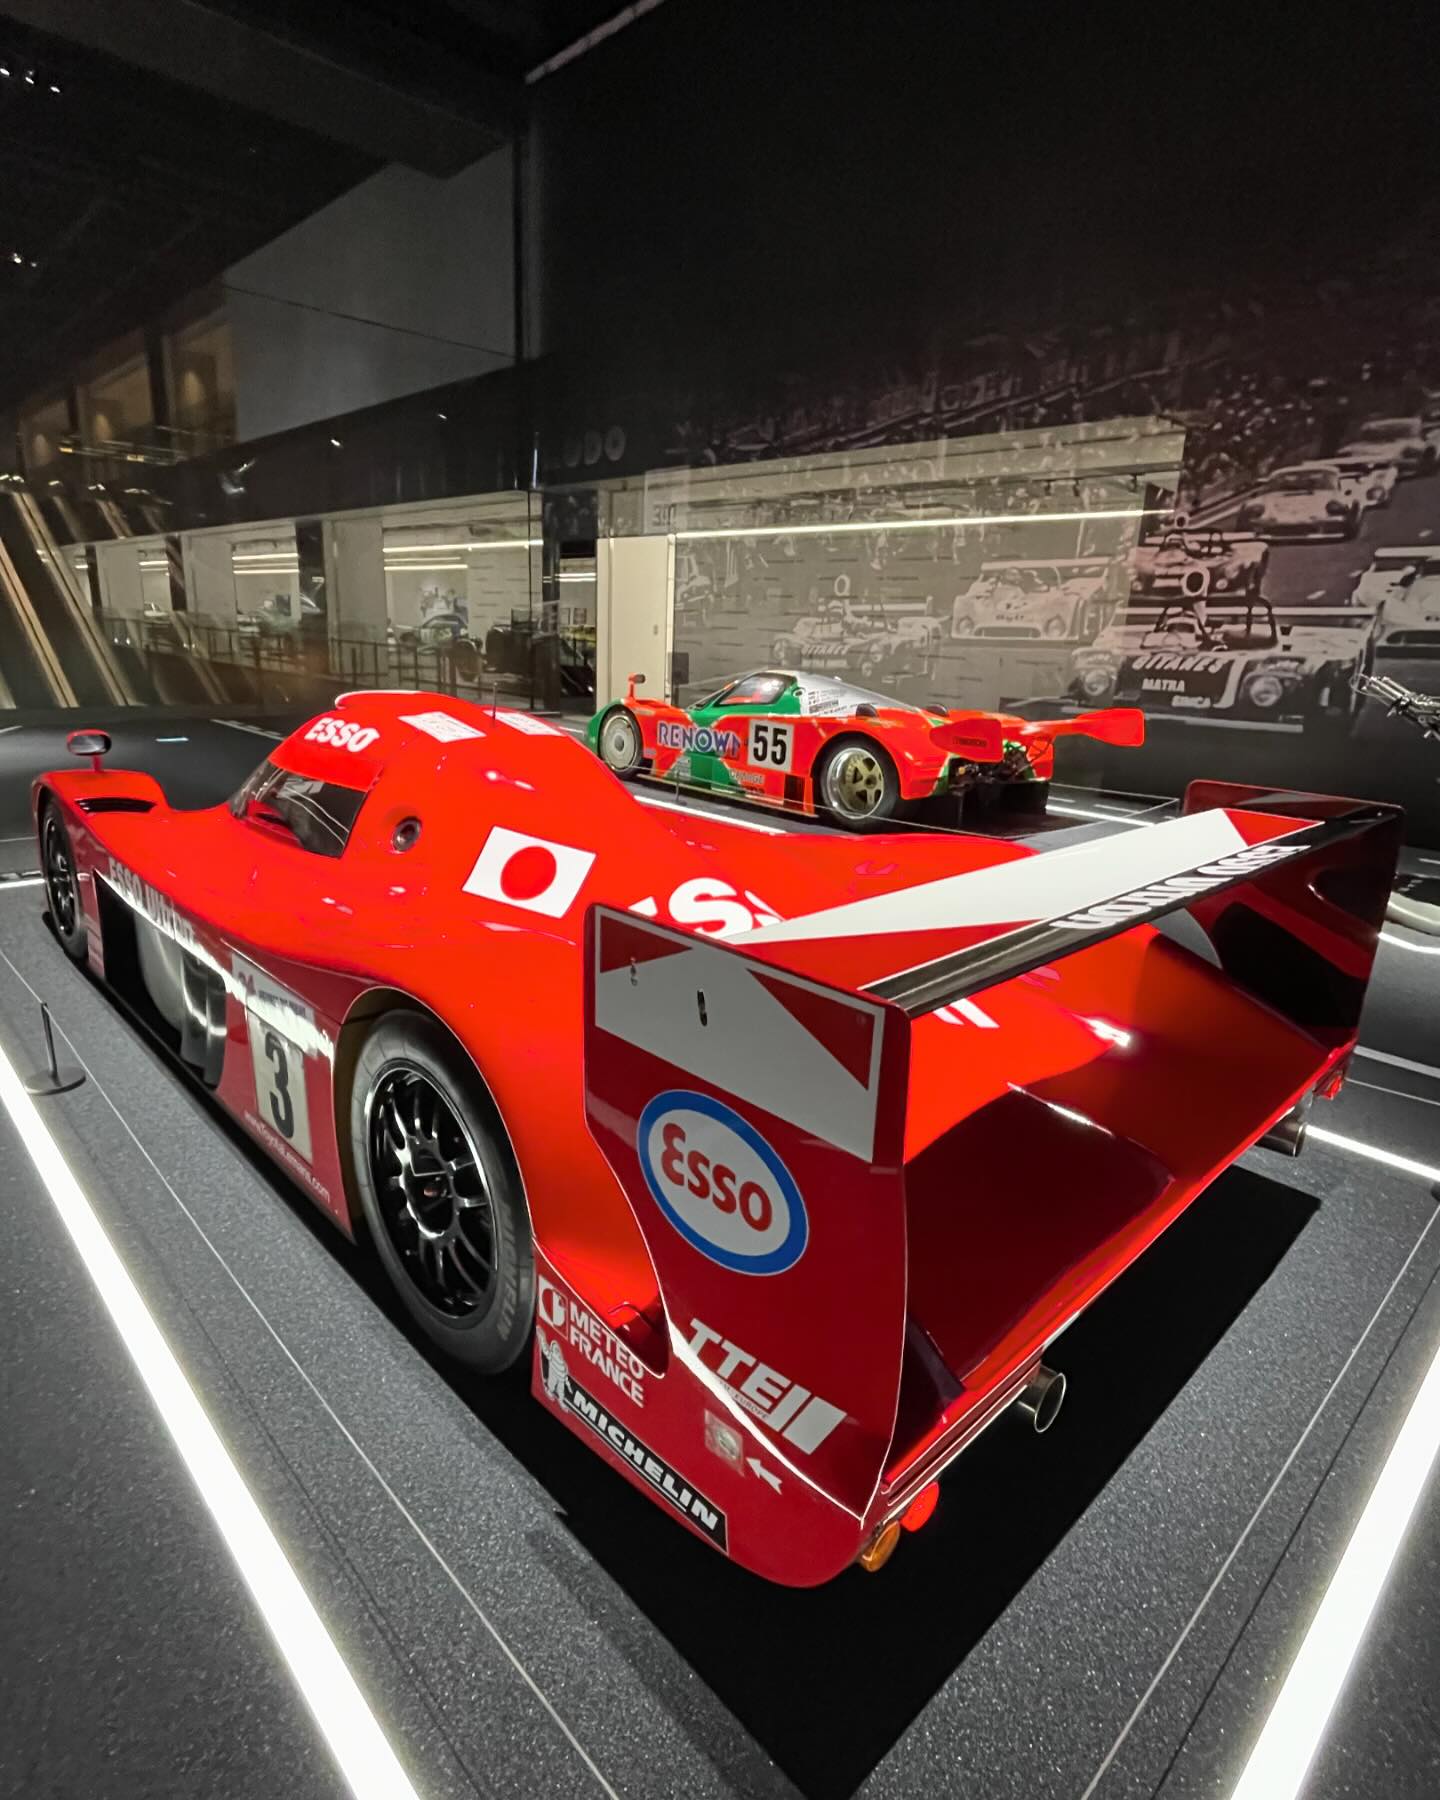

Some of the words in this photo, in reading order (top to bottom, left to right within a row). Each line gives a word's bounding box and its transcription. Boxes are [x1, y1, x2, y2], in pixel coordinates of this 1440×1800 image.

[304, 717, 380, 752] ESSO
[753, 724, 788, 765] 55
[265, 1031, 294, 1138] 3
[570, 1325, 644, 1408] FRANCE
[573, 1389, 718, 1531] MICHELIN
